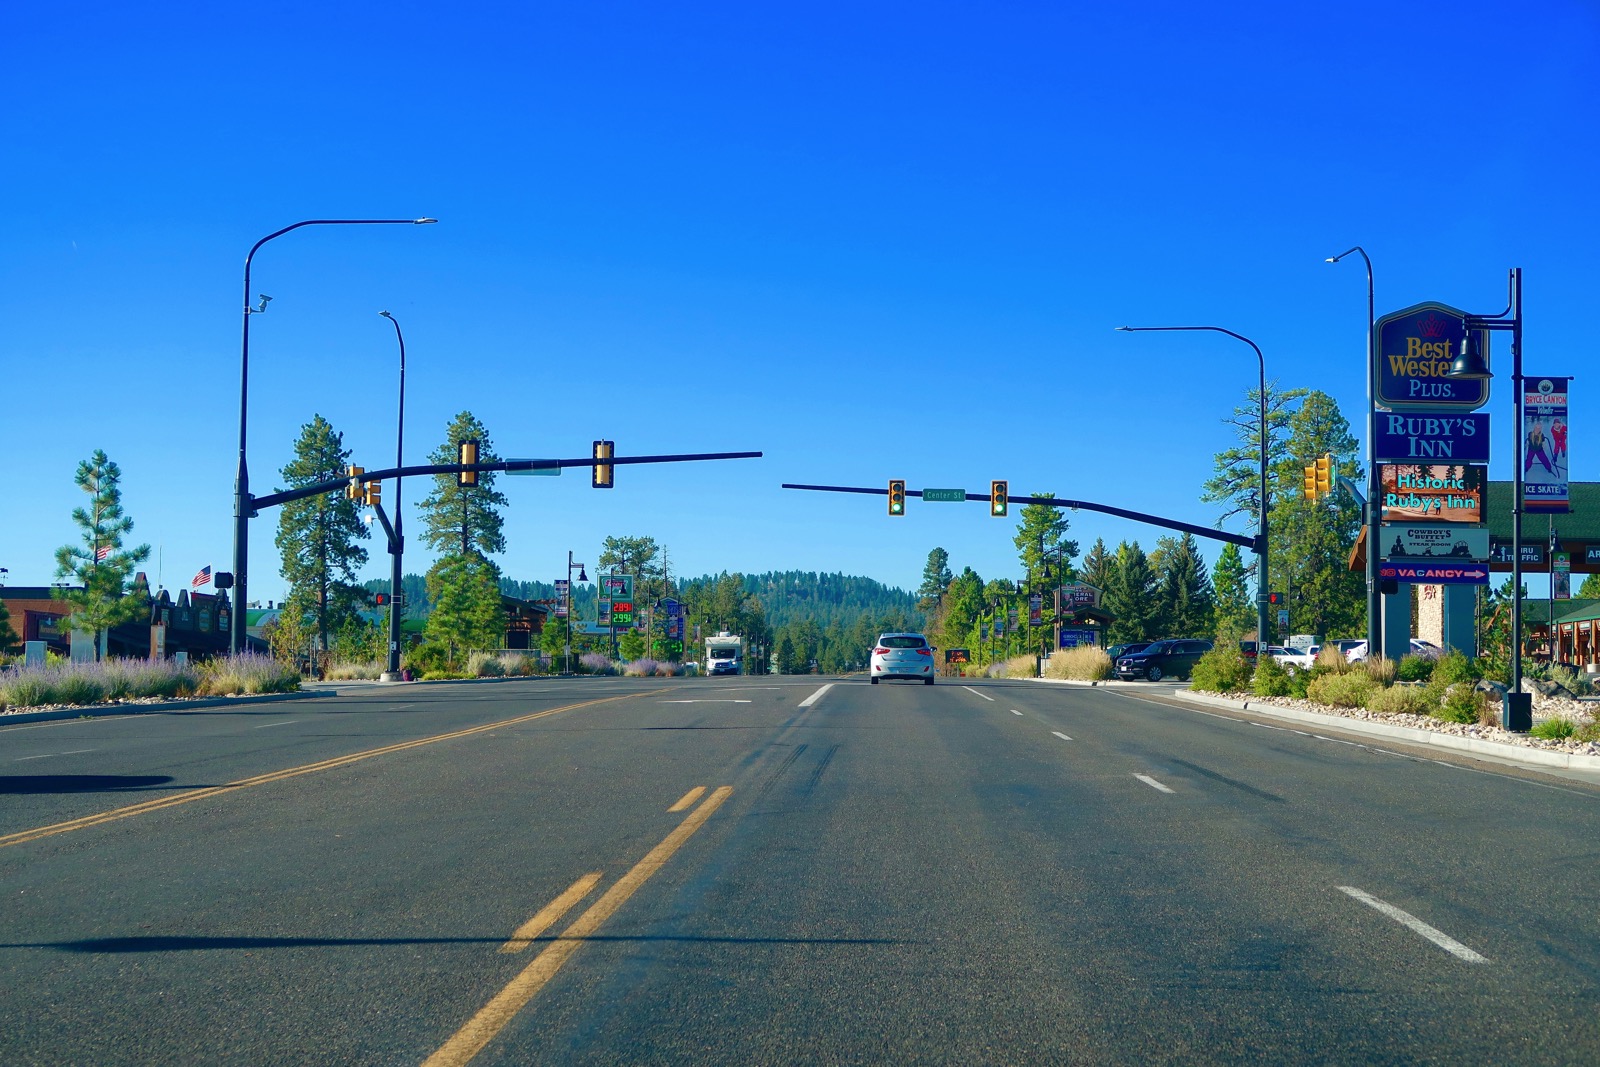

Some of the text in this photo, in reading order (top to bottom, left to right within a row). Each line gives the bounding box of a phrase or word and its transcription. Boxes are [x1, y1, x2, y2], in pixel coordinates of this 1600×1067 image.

[1406, 337, 1453, 359] Best
[1388, 355, 1454, 377] Weste
[1525, 394, 1566, 404] BRYCE CANYON
[1386, 415, 1476, 436] RUBY'S
[1407, 436, 1454, 457] INN
[1397, 474, 1465, 490] Historic
[1525, 485, 1536, 493] ICE
[927, 491, 961, 499] Center St
[1386, 493, 1476, 511] Rubys Inn
[1407, 529, 1452, 537] COWBOY'S
[1398, 569, 1464, 577] VACANCY
